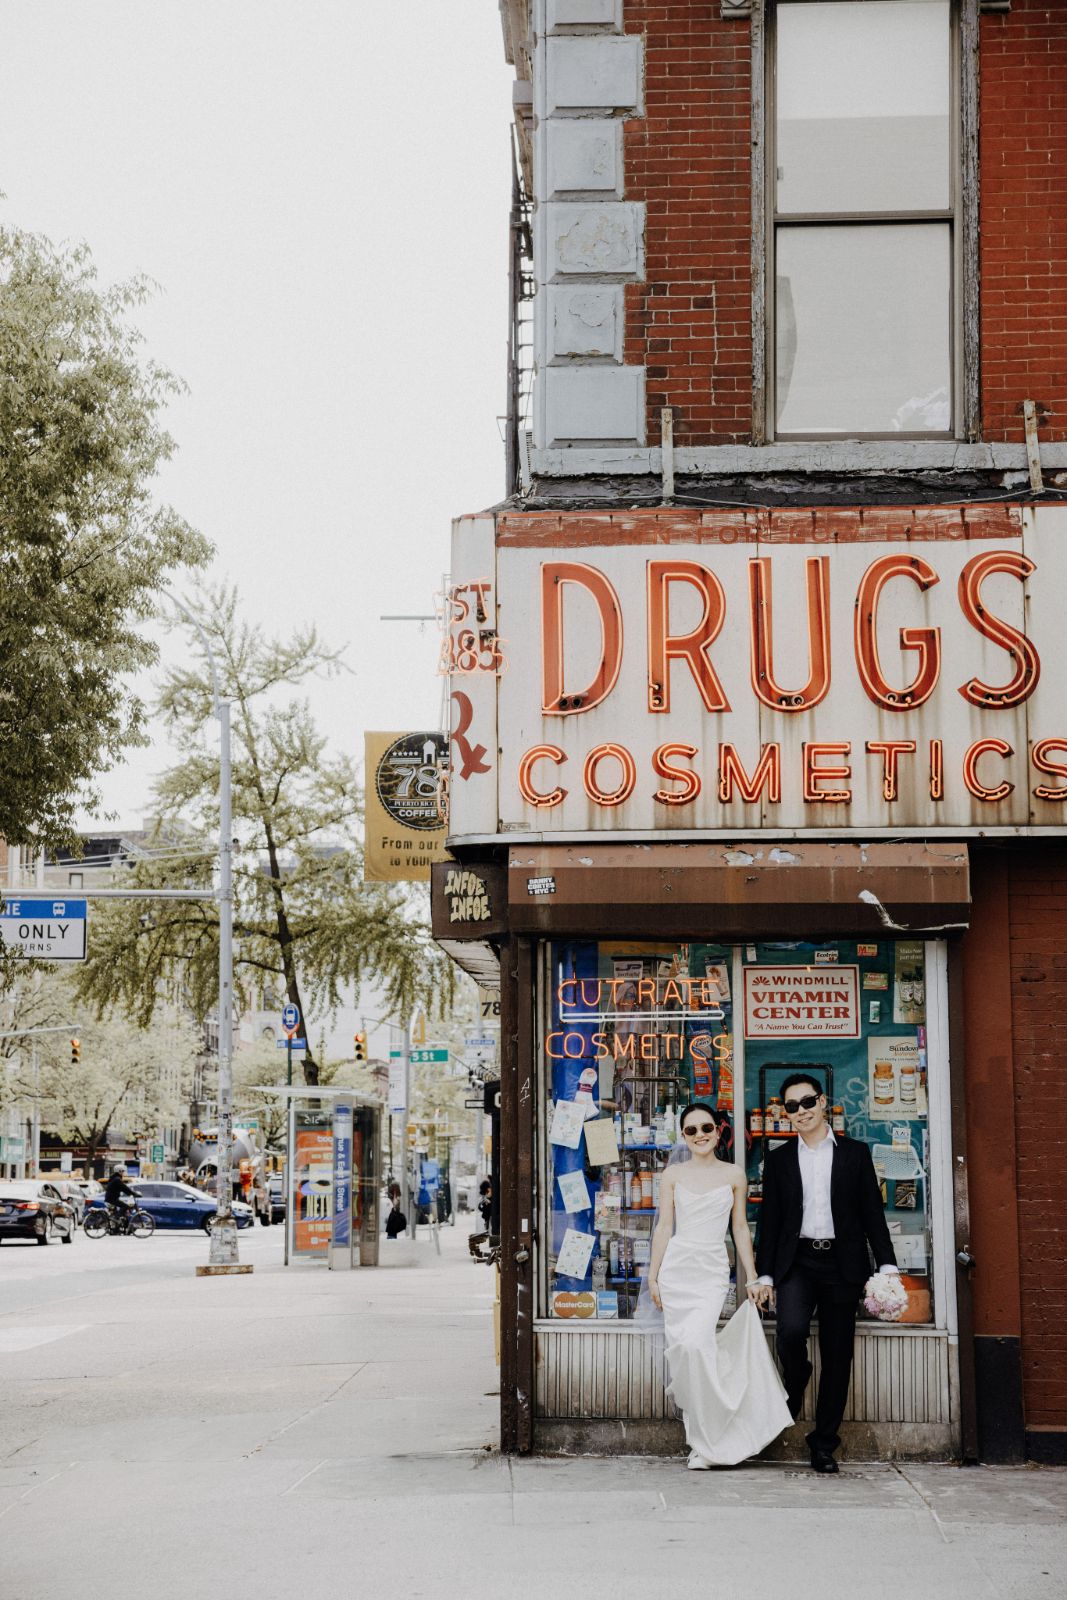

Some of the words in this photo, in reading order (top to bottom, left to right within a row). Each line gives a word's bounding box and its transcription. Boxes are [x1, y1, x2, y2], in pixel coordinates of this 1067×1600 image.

[541, 550, 1037, 716] DRUGS
[518, 738, 1067, 807] COSMETICS
[398, 808, 437, 818] COFFEE
[382, 836, 413, 850] From
[418, 841, 438, 850] our
[19, 924, 69, 939] ONLY
[773, 976, 849, 986] WINDMILL
[557, 980, 625, 1006] CUT
[638, 979, 720, 1006] RATE
[752, 991, 849, 1003] VITAMIN
[752, 1007, 850, 1019] CENTER
[766, 1023, 789, 1031] Name
[545, 1032, 730, 1060] COSMETICS
[422, 1052, 435, 1061] St
[554, 1301, 595, 1309] MasterCard
